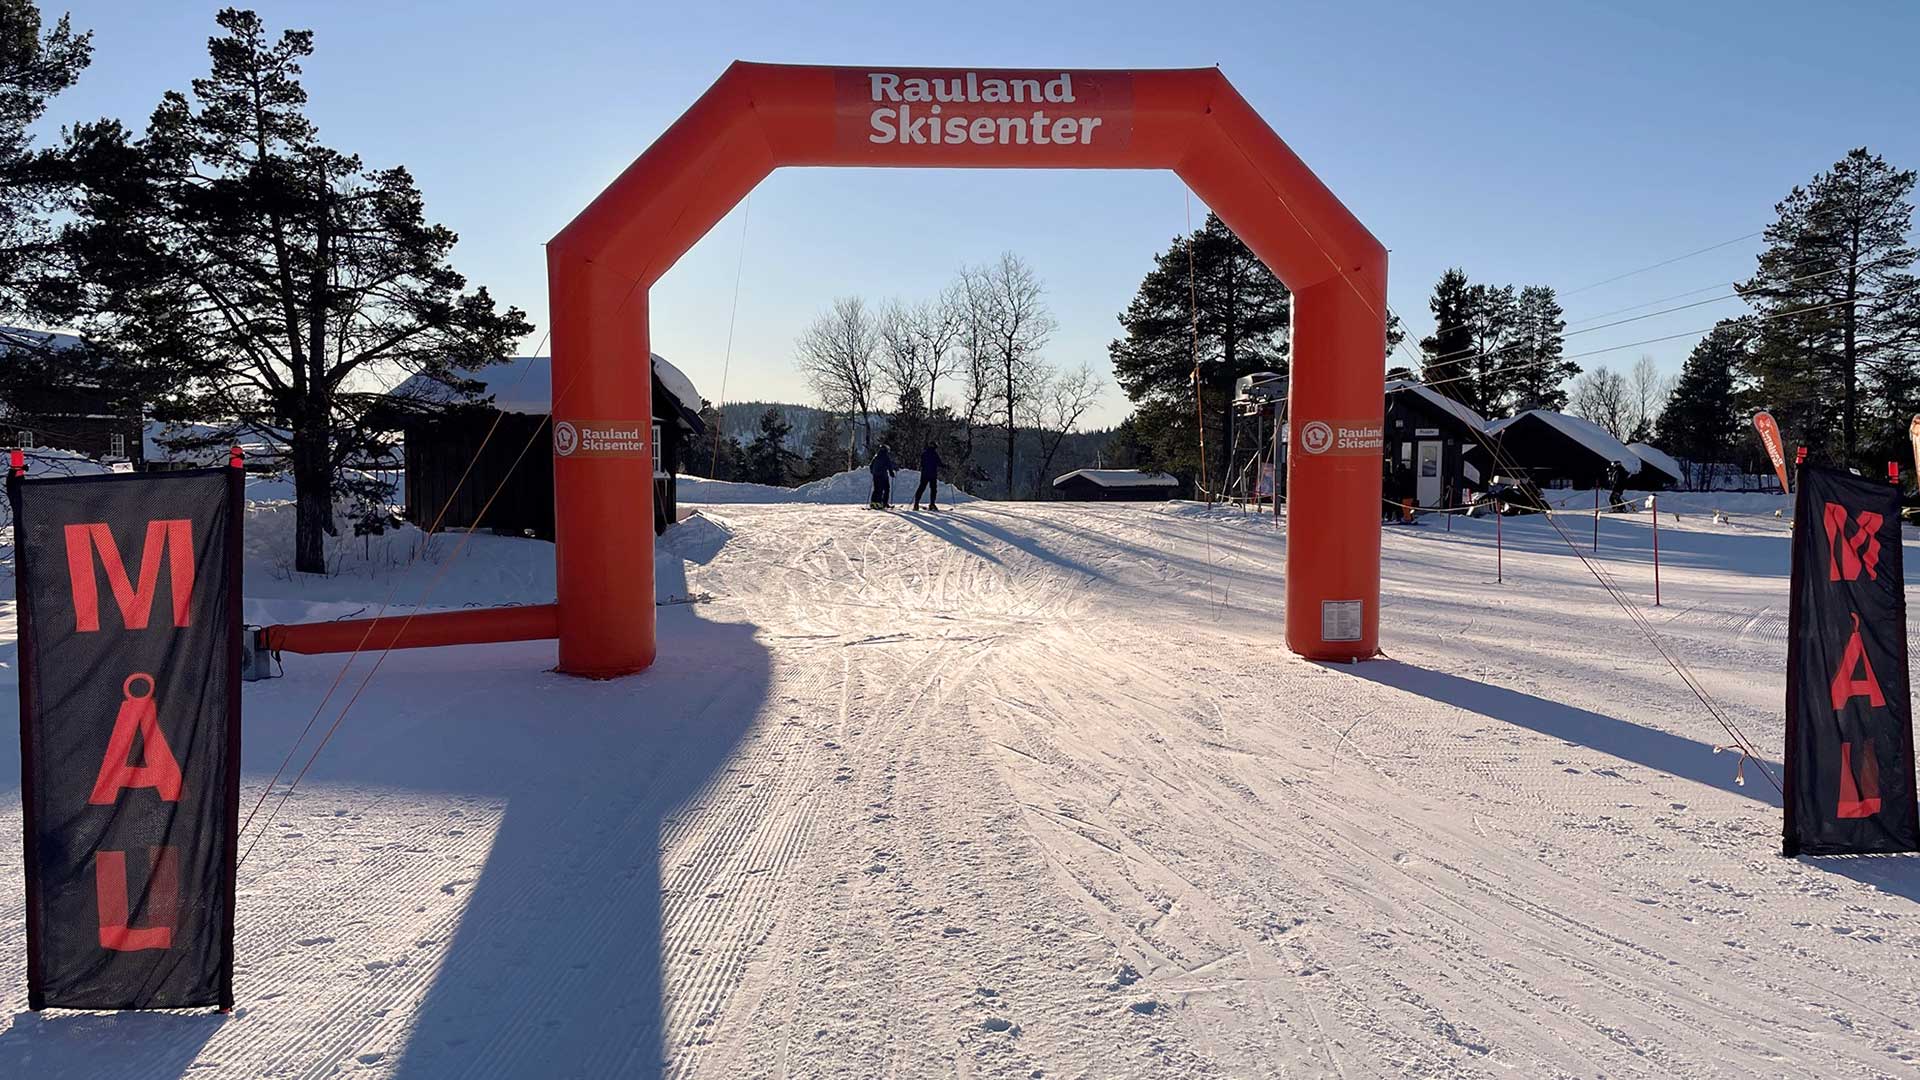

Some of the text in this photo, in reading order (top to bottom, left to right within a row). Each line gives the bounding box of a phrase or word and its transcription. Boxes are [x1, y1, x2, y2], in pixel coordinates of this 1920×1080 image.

[868, 72, 1076, 103] Rauland
[869, 104, 1102, 145] Skisenter
[582, 428, 639, 440] Rauland
[582, 439, 645, 451] Skisenter
[64, 519, 195, 952] MÅL
